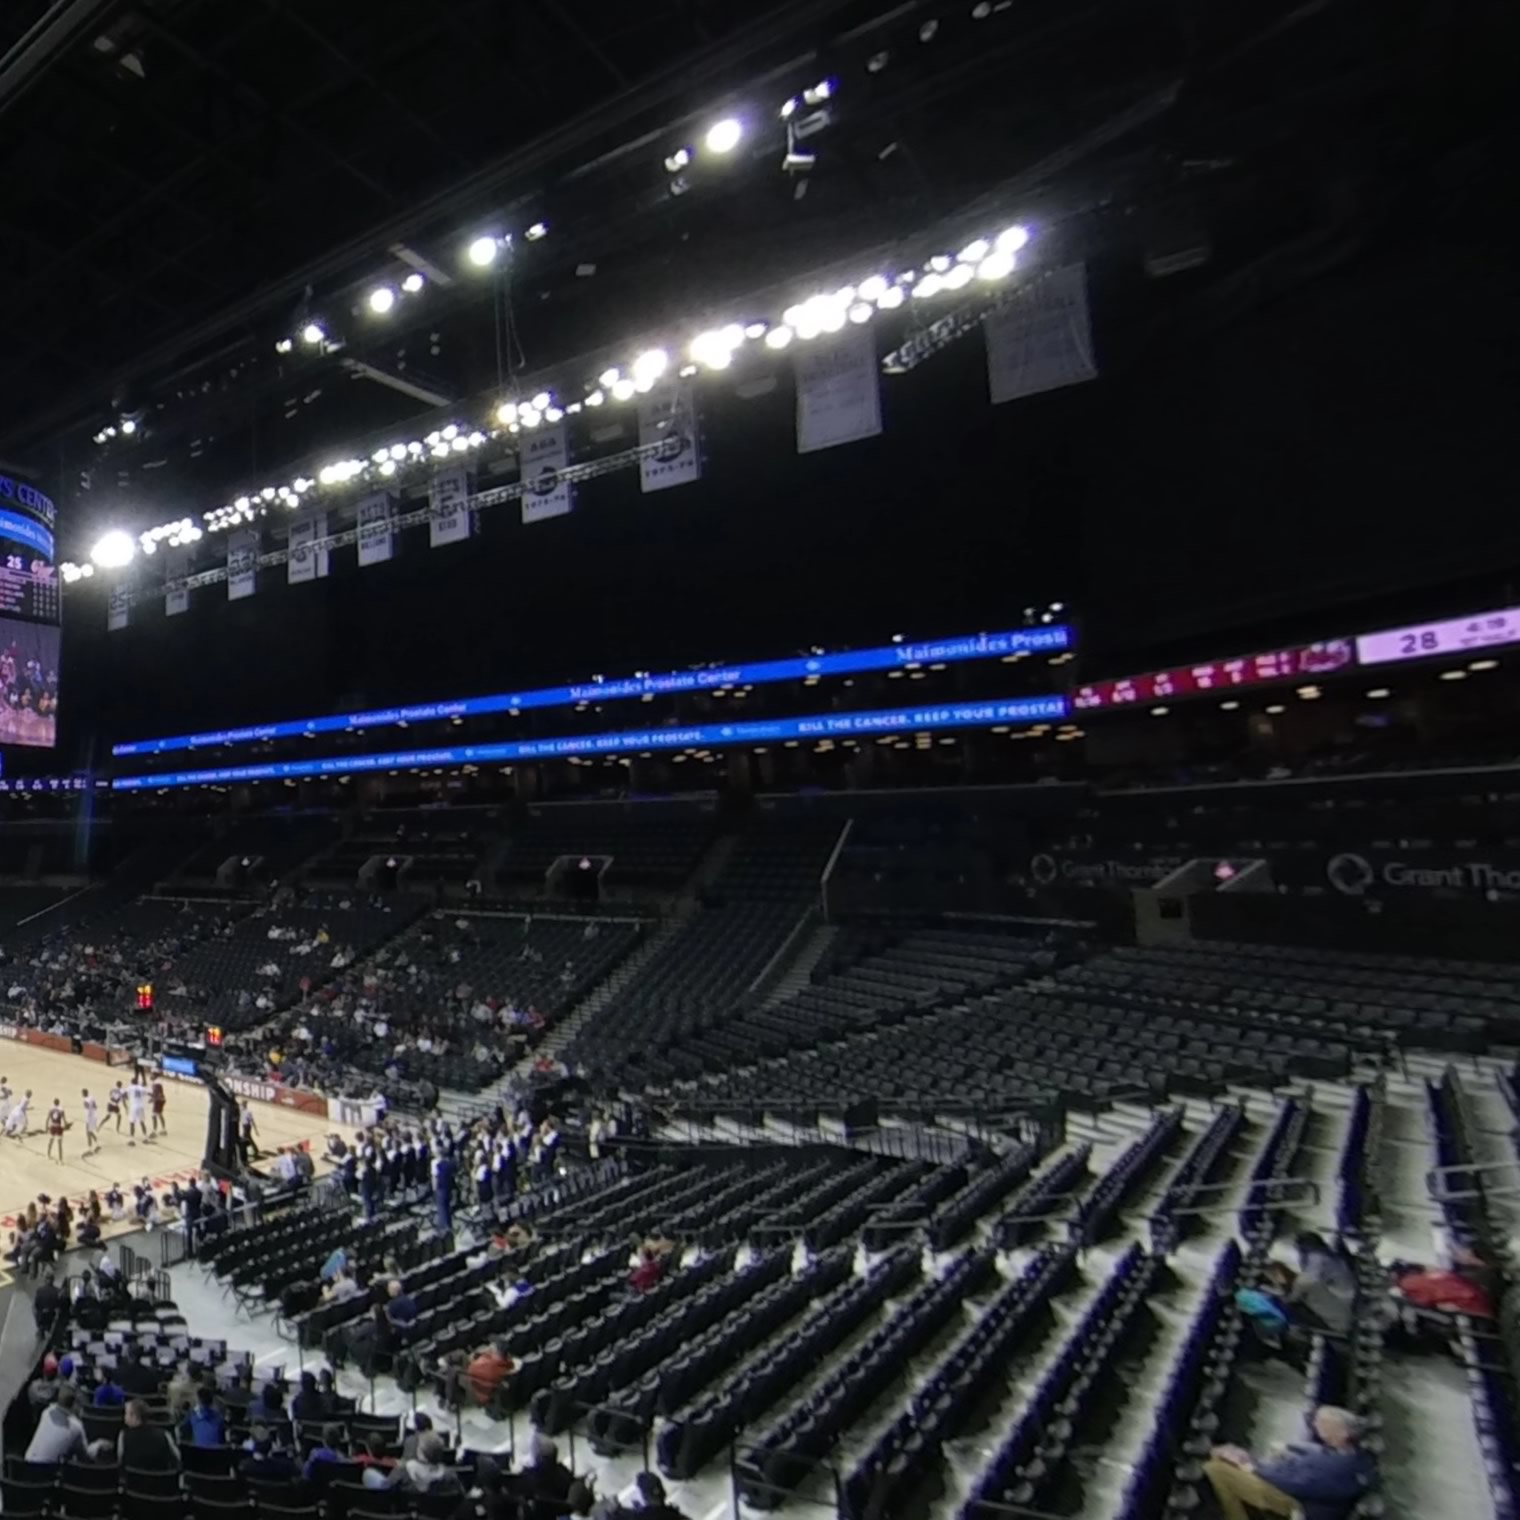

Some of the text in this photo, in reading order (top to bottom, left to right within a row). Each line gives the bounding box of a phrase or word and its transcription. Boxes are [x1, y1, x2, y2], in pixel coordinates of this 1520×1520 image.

[7, 555, 23, 569] 25
[896, 637, 1007, 661] Maimonides
[1399, 631, 1439, 653] 28
[570, 670, 741, 698] Maimonides Prostate Center
[827, 717, 850, 730] THE
[854, 713, 912, 728] CANCER.
[914, 711, 950, 722] KEEP
[953, 707, 994, 720] YOUR
[1383, 862, 1463, 886] Grant
